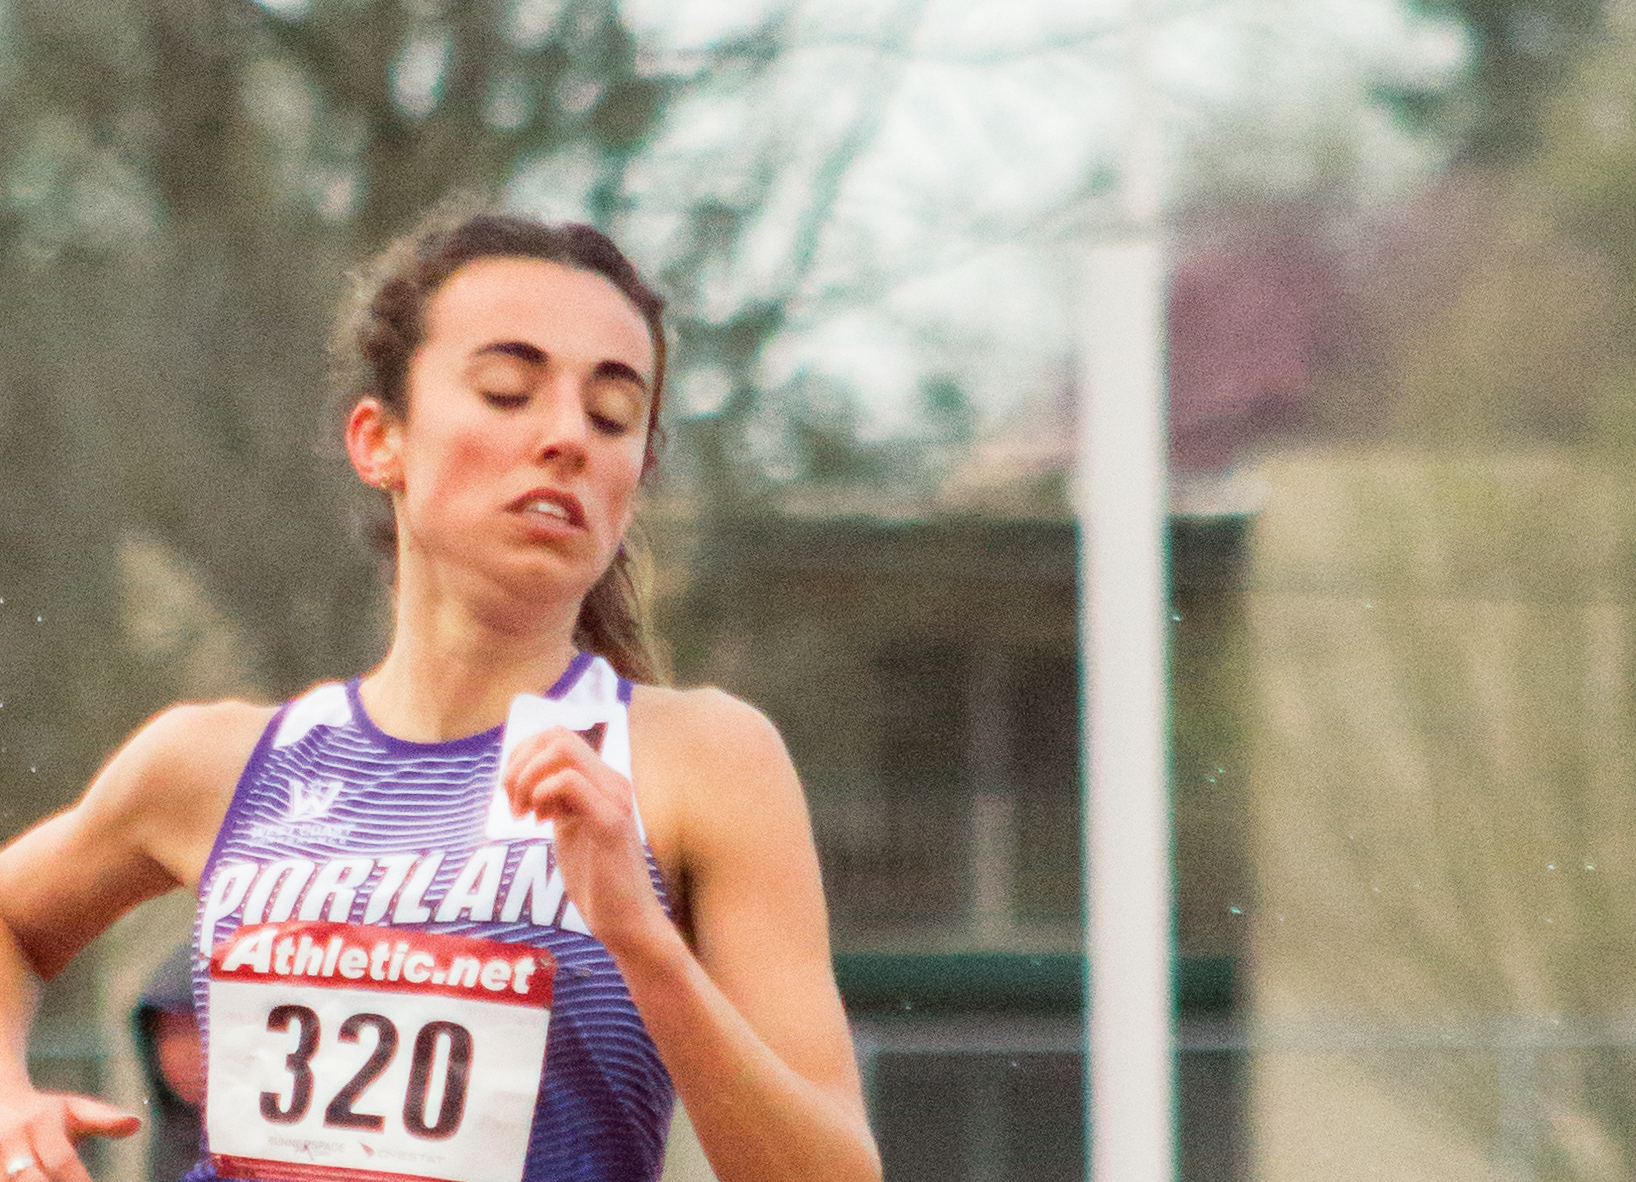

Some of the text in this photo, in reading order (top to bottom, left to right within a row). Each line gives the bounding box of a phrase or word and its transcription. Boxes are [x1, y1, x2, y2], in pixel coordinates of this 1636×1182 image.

[200, 845, 592, 958] PORTLAN
[221, 927, 536, 994] Athletic.net
[259, 1004, 473, 1141] 320
